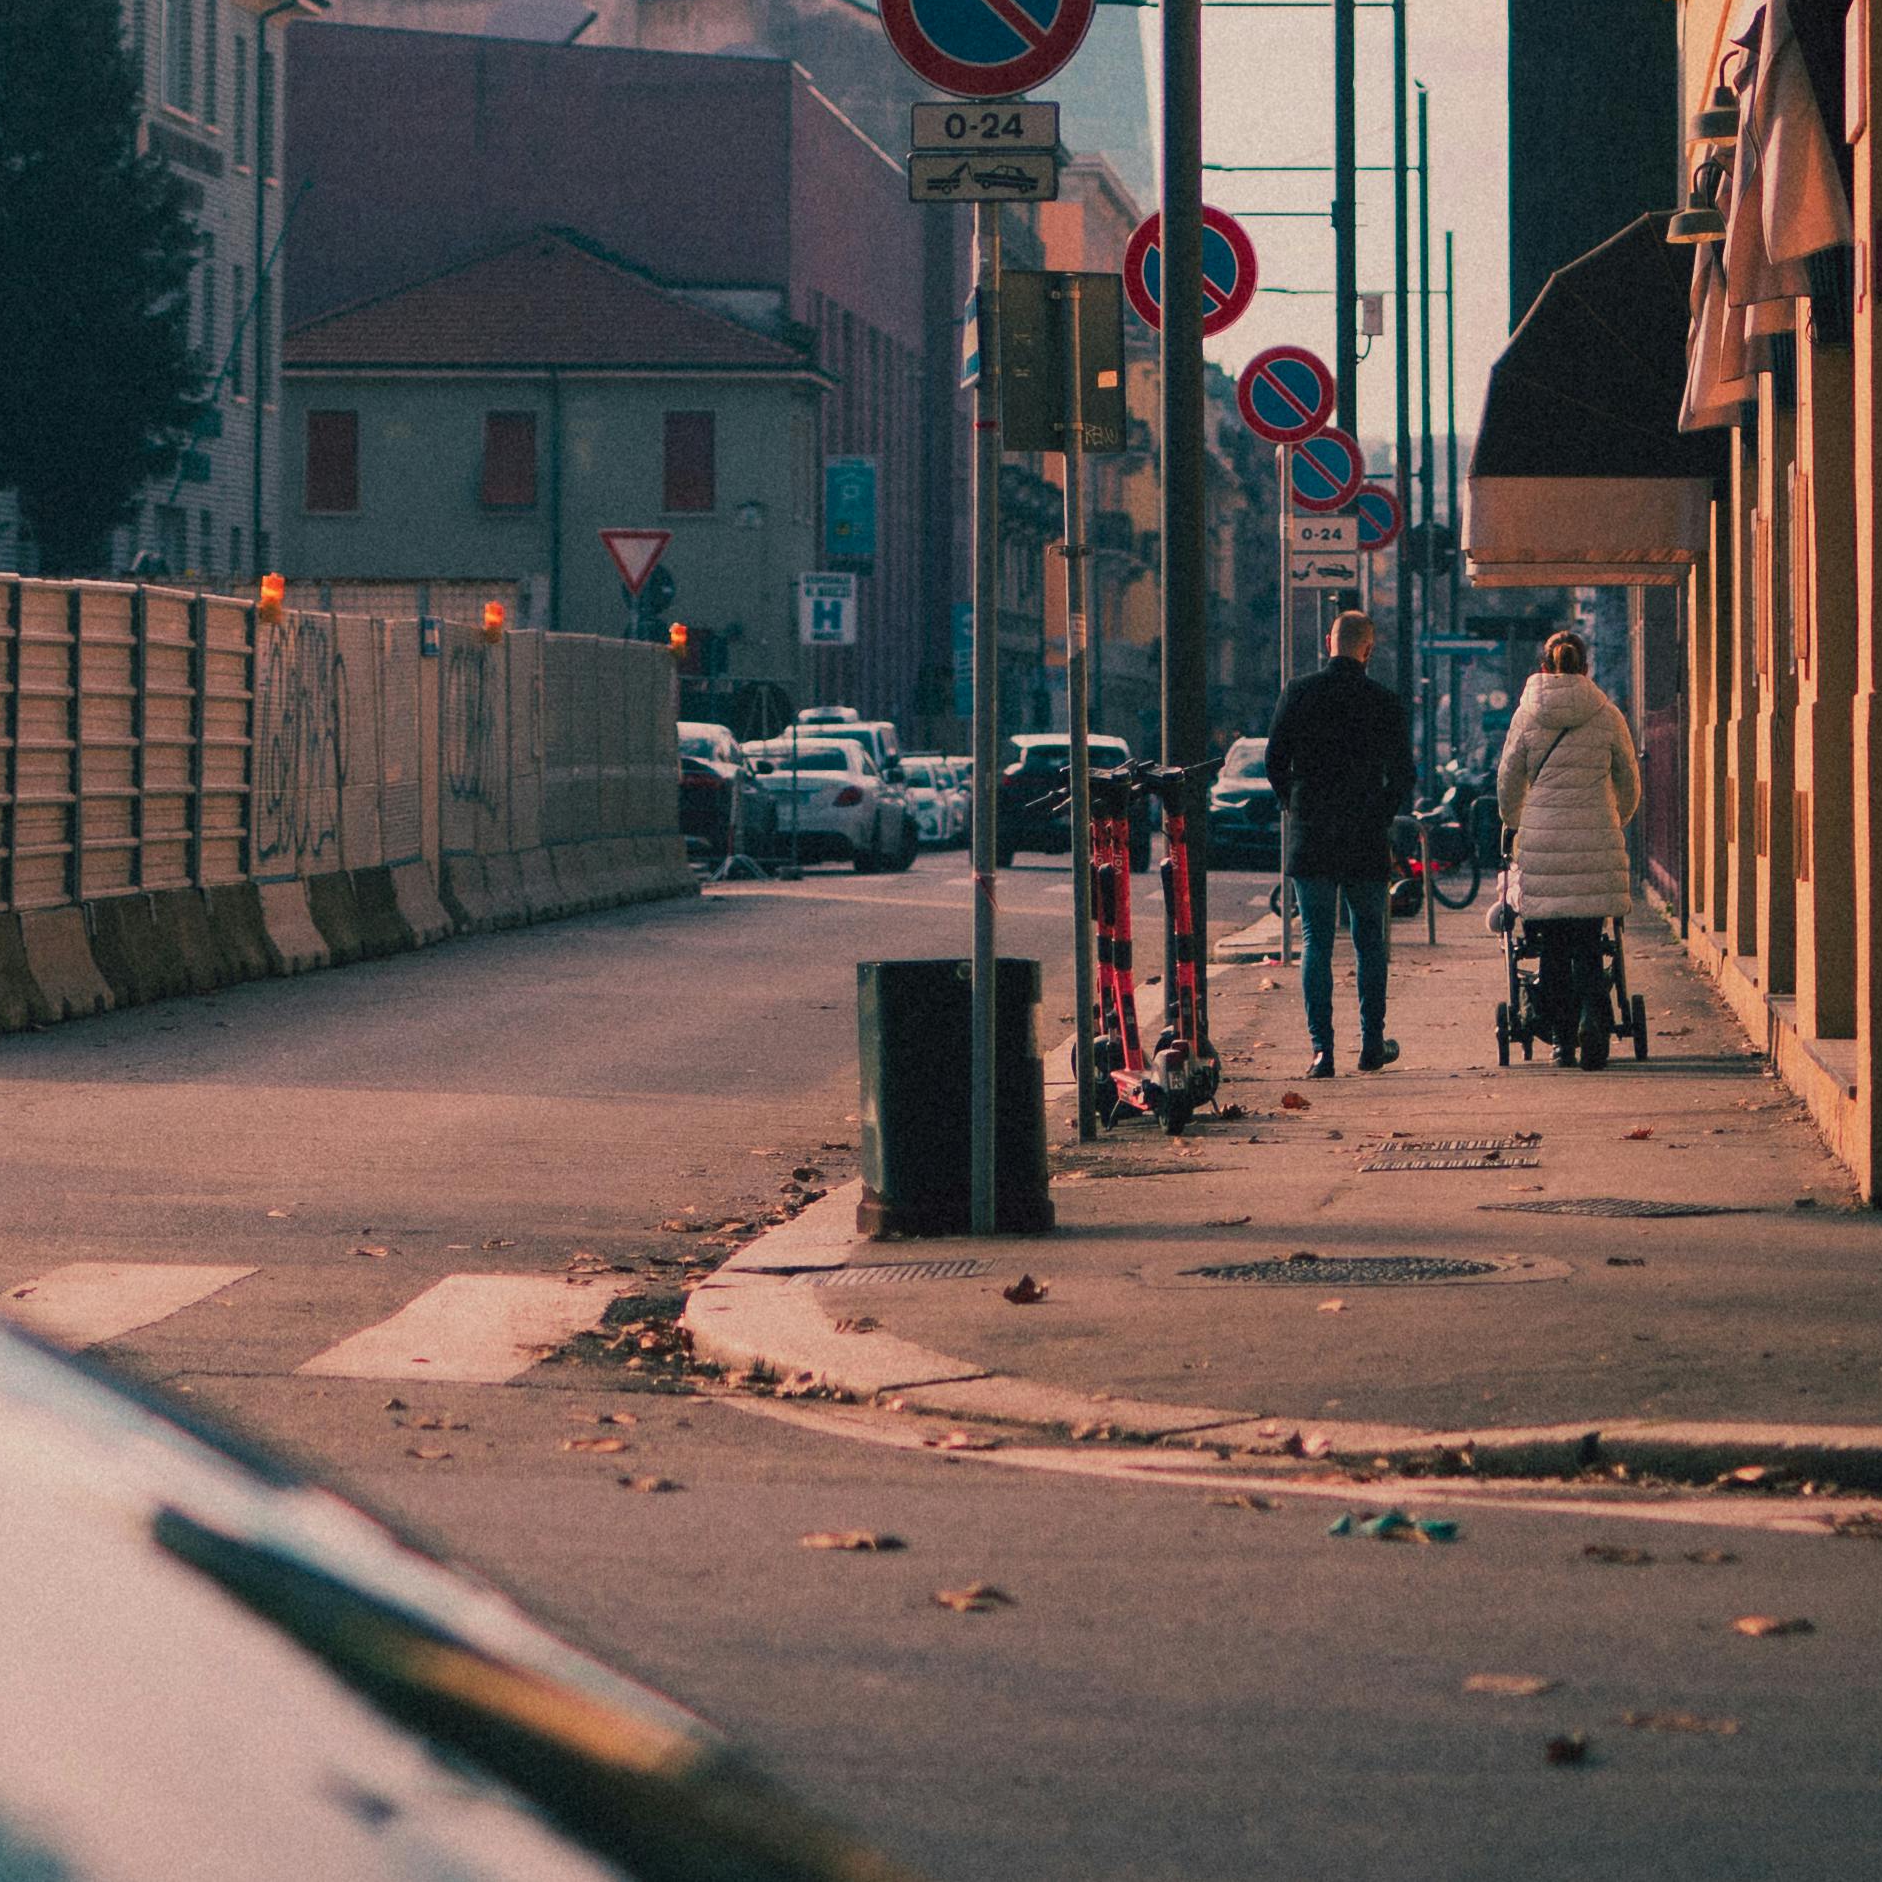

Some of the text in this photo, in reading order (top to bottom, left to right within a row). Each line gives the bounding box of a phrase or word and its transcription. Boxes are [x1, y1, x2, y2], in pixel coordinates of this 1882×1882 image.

[945, 112, 1024, 139] 0-24
[1302, 527, 1342, 540] 0-24
[813, 600, 842, 630] H
